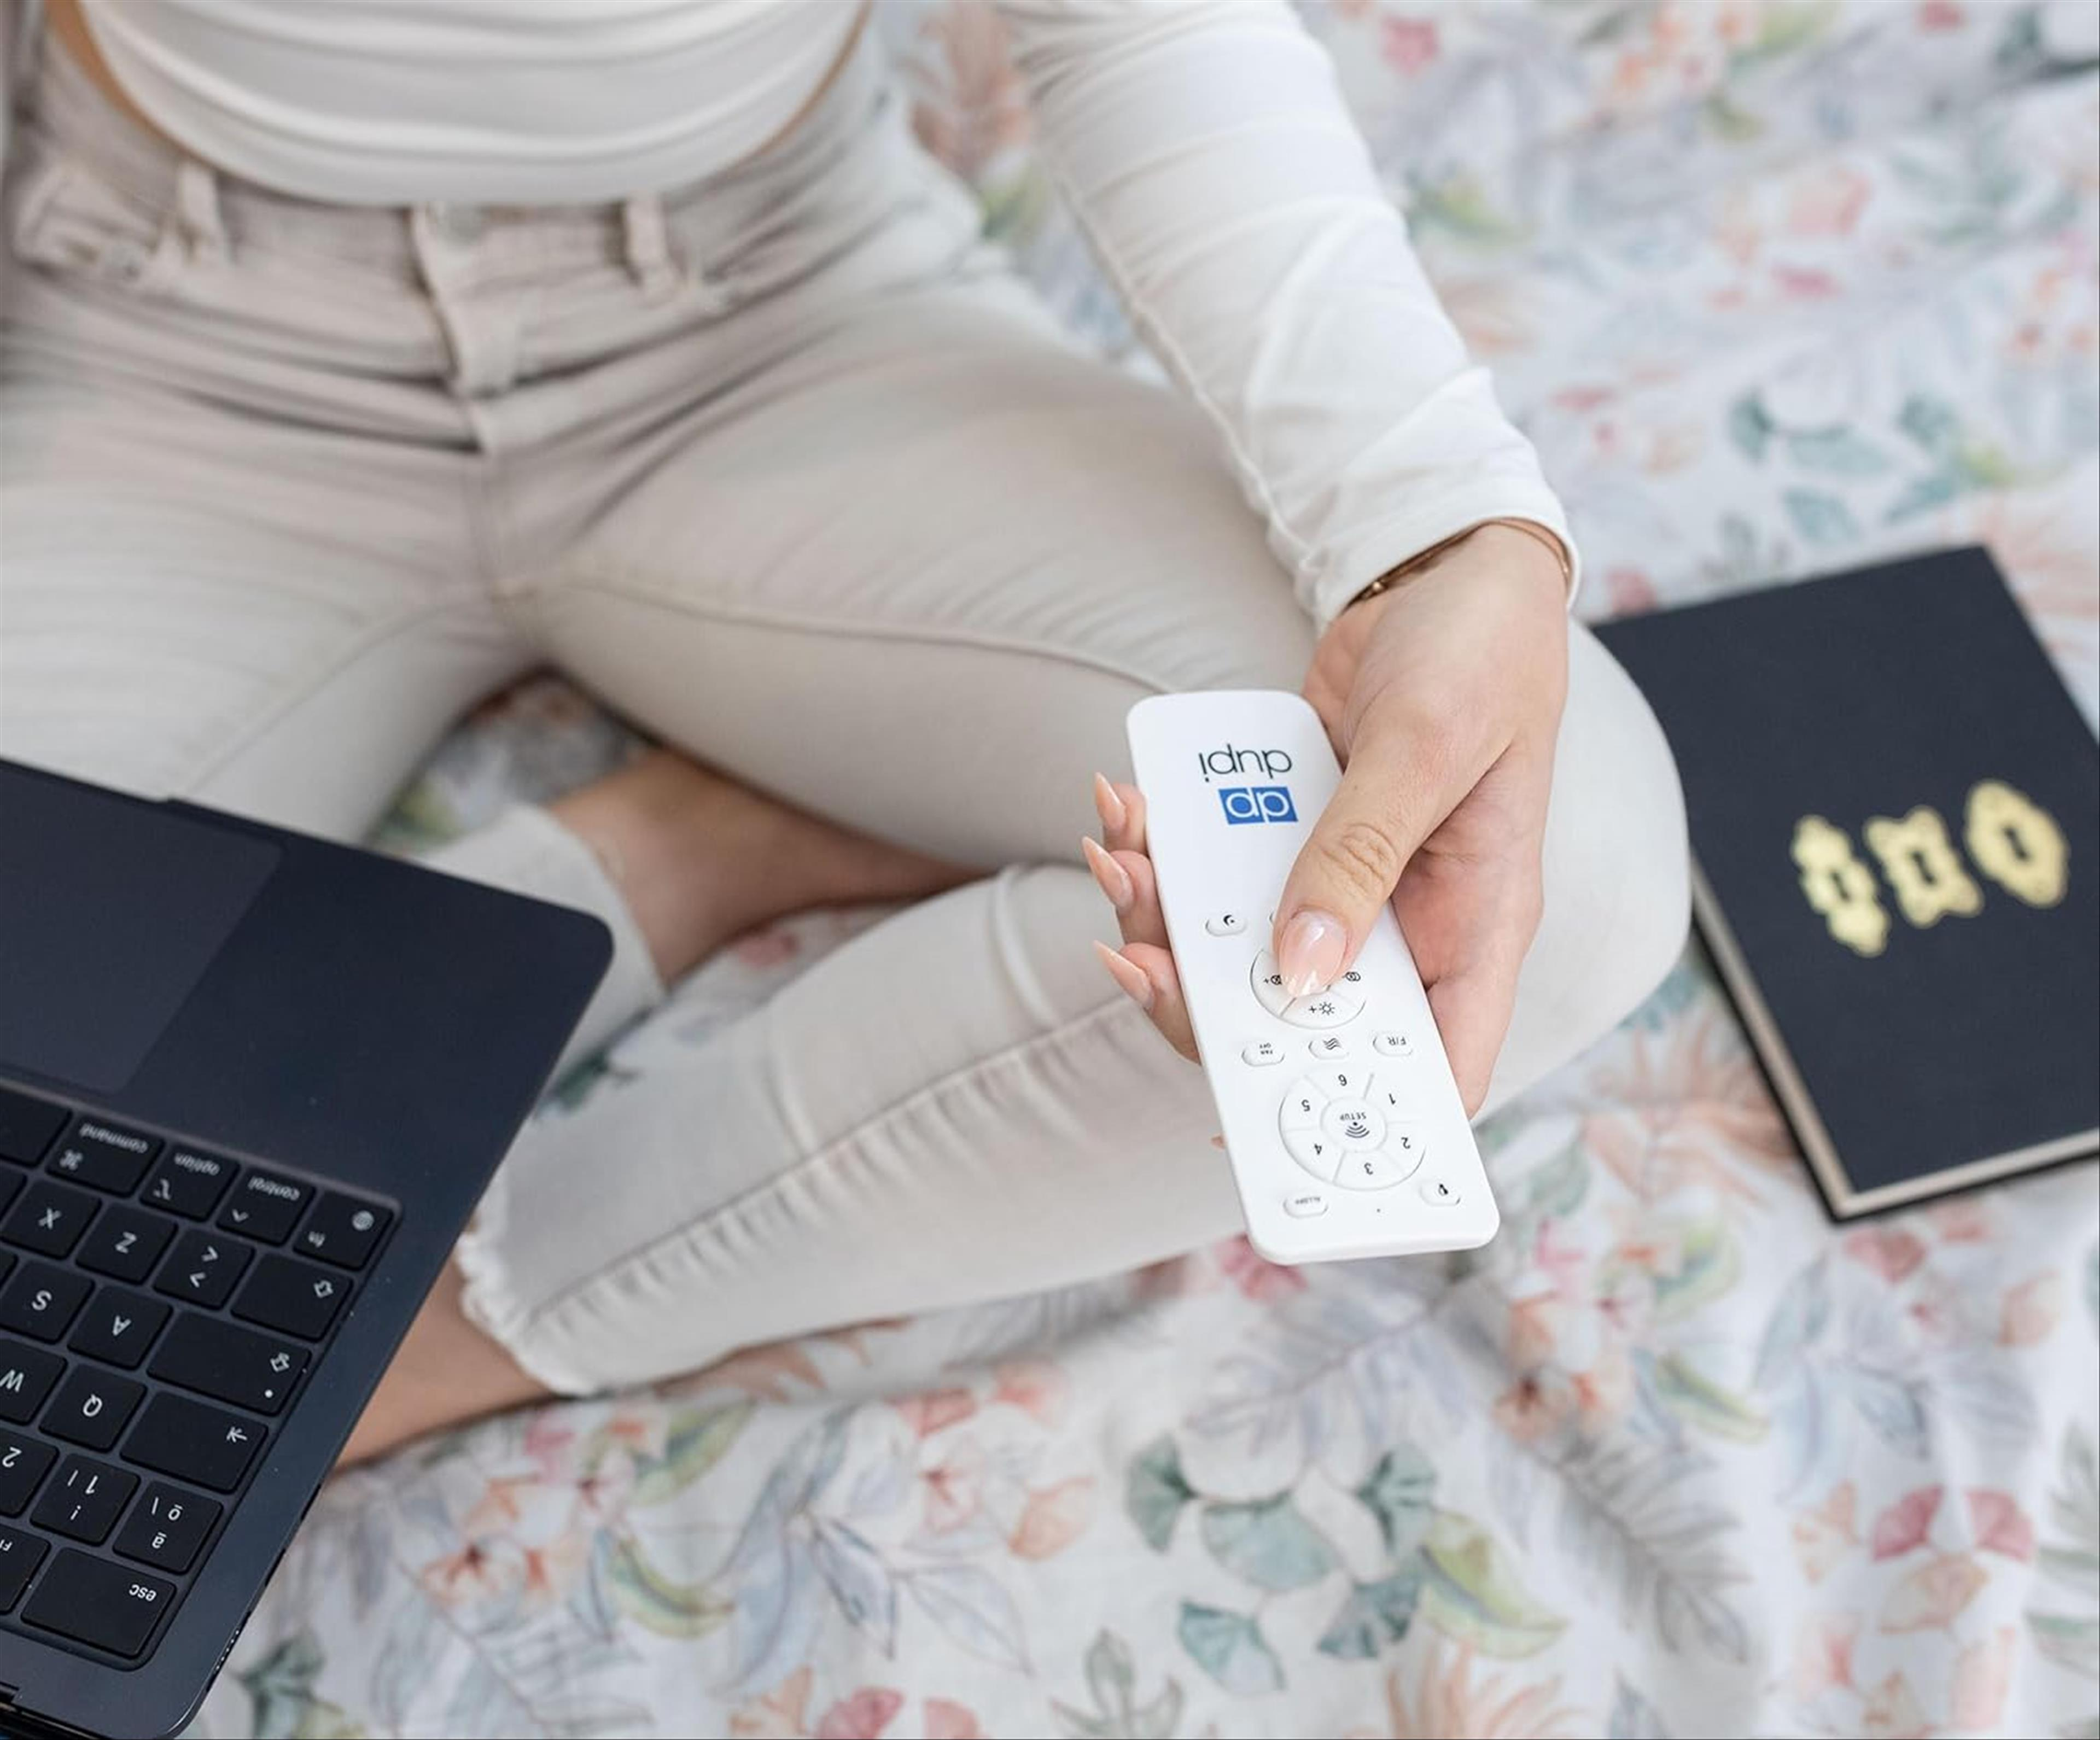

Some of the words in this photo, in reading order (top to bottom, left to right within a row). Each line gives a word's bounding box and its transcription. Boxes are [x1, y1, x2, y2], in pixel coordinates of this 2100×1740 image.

[1198, 743, 1292, 783] dupi
[1388, 1037, 1406, 1046] F/R
[1338, 1075, 1347, 1086] 6
[1302, 1100, 1310, 1112] 5
[1389, 1094, 1396, 1105] 1
[1339, 1112, 1367, 1121] SETUP
[1315, 1144, 1322, 1154] 4
[1401, 1137, 1410, 1149] 2
[174, 1152, 220, 1176] option
[1364, 1163, 1373, 1175] 3
[248, 1176, 300, 1201] control
[39, 1208, 60, 1228] X
[116, 1233, 136, 1253] Z
[32, 1291, 51, 1310] S
[113, 1316, 131, 1335] A
[0, 1370, 24, 1392] W
[83, 1394, 102, 1416] Q
[3, 1447, 21, 1467] 2
[86, 1476, 97, 1494] 1
[71, 1505, 81, 1520] !
[130, 1585, 156, 1601] esc
